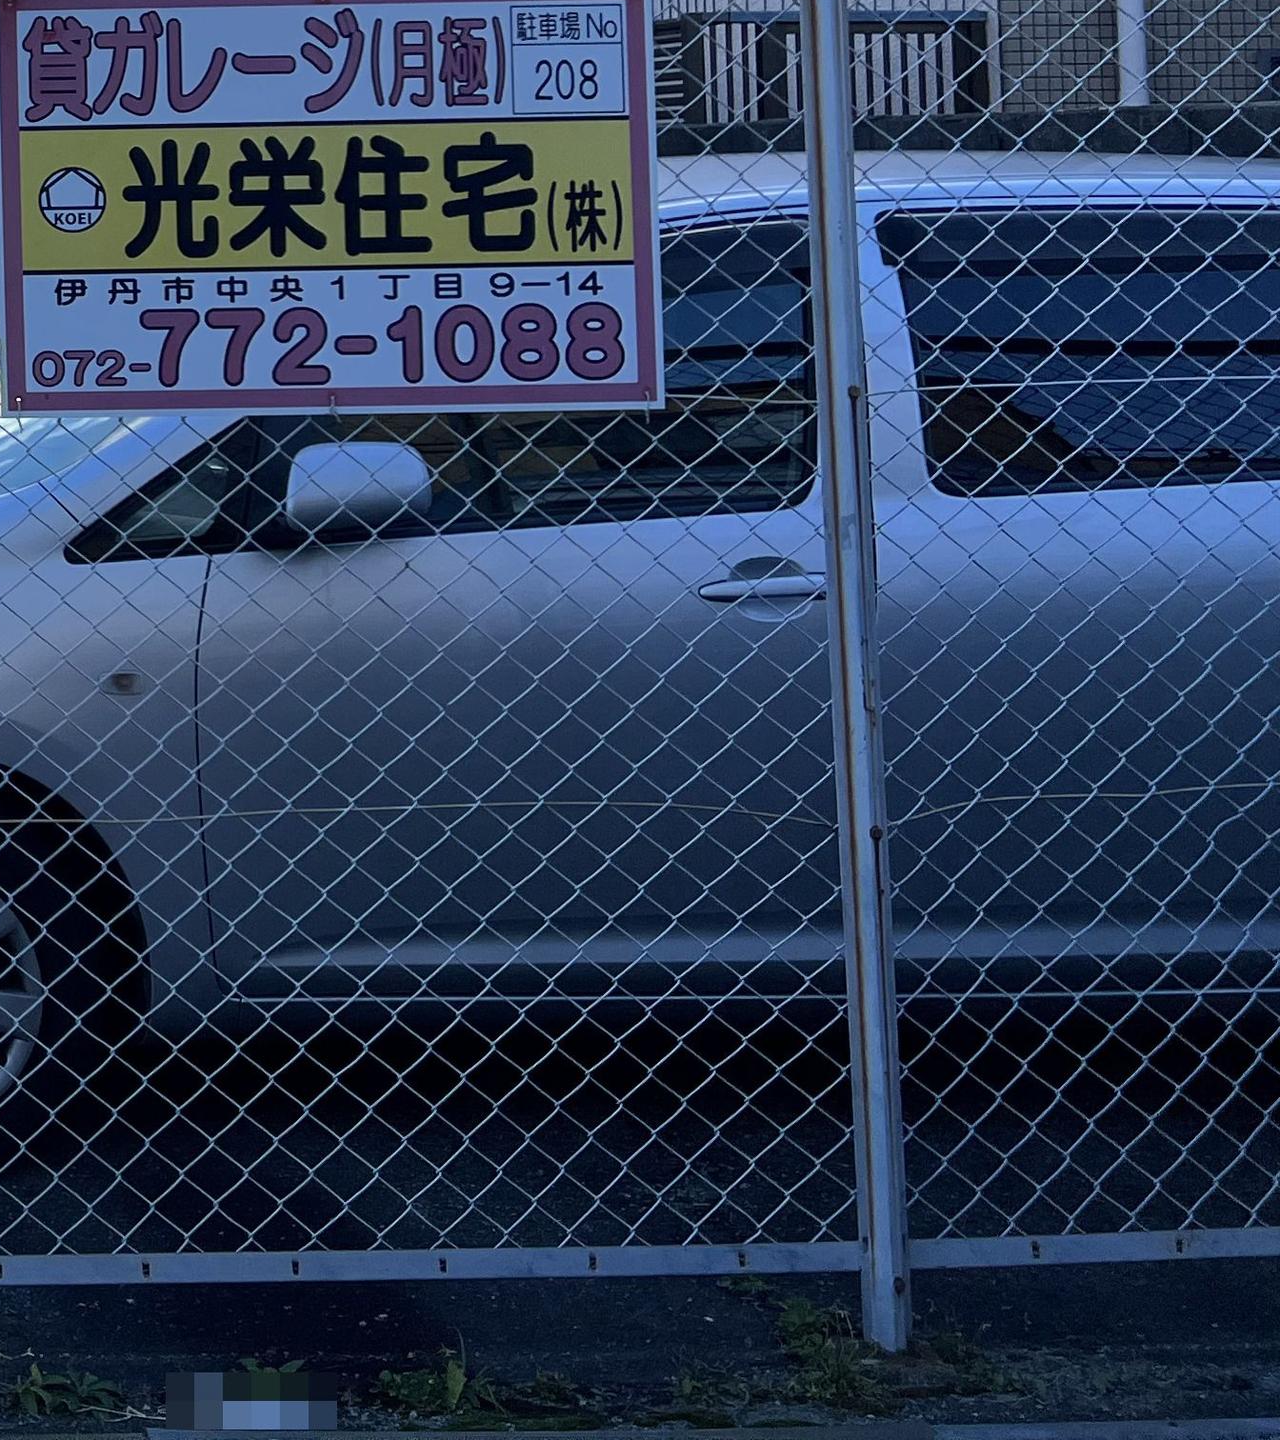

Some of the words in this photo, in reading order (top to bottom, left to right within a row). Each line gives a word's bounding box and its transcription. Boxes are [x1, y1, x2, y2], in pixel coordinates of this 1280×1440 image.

[22, 7, 506, 122] 貸ガレージ(月極)
[533, 58, 600, 102] 208
[53, 210, 93, 226] KOEI
[122, 131, 624, 260] 光栄住宅(株)
[32, 301, 626, 389] 072-772-1088
